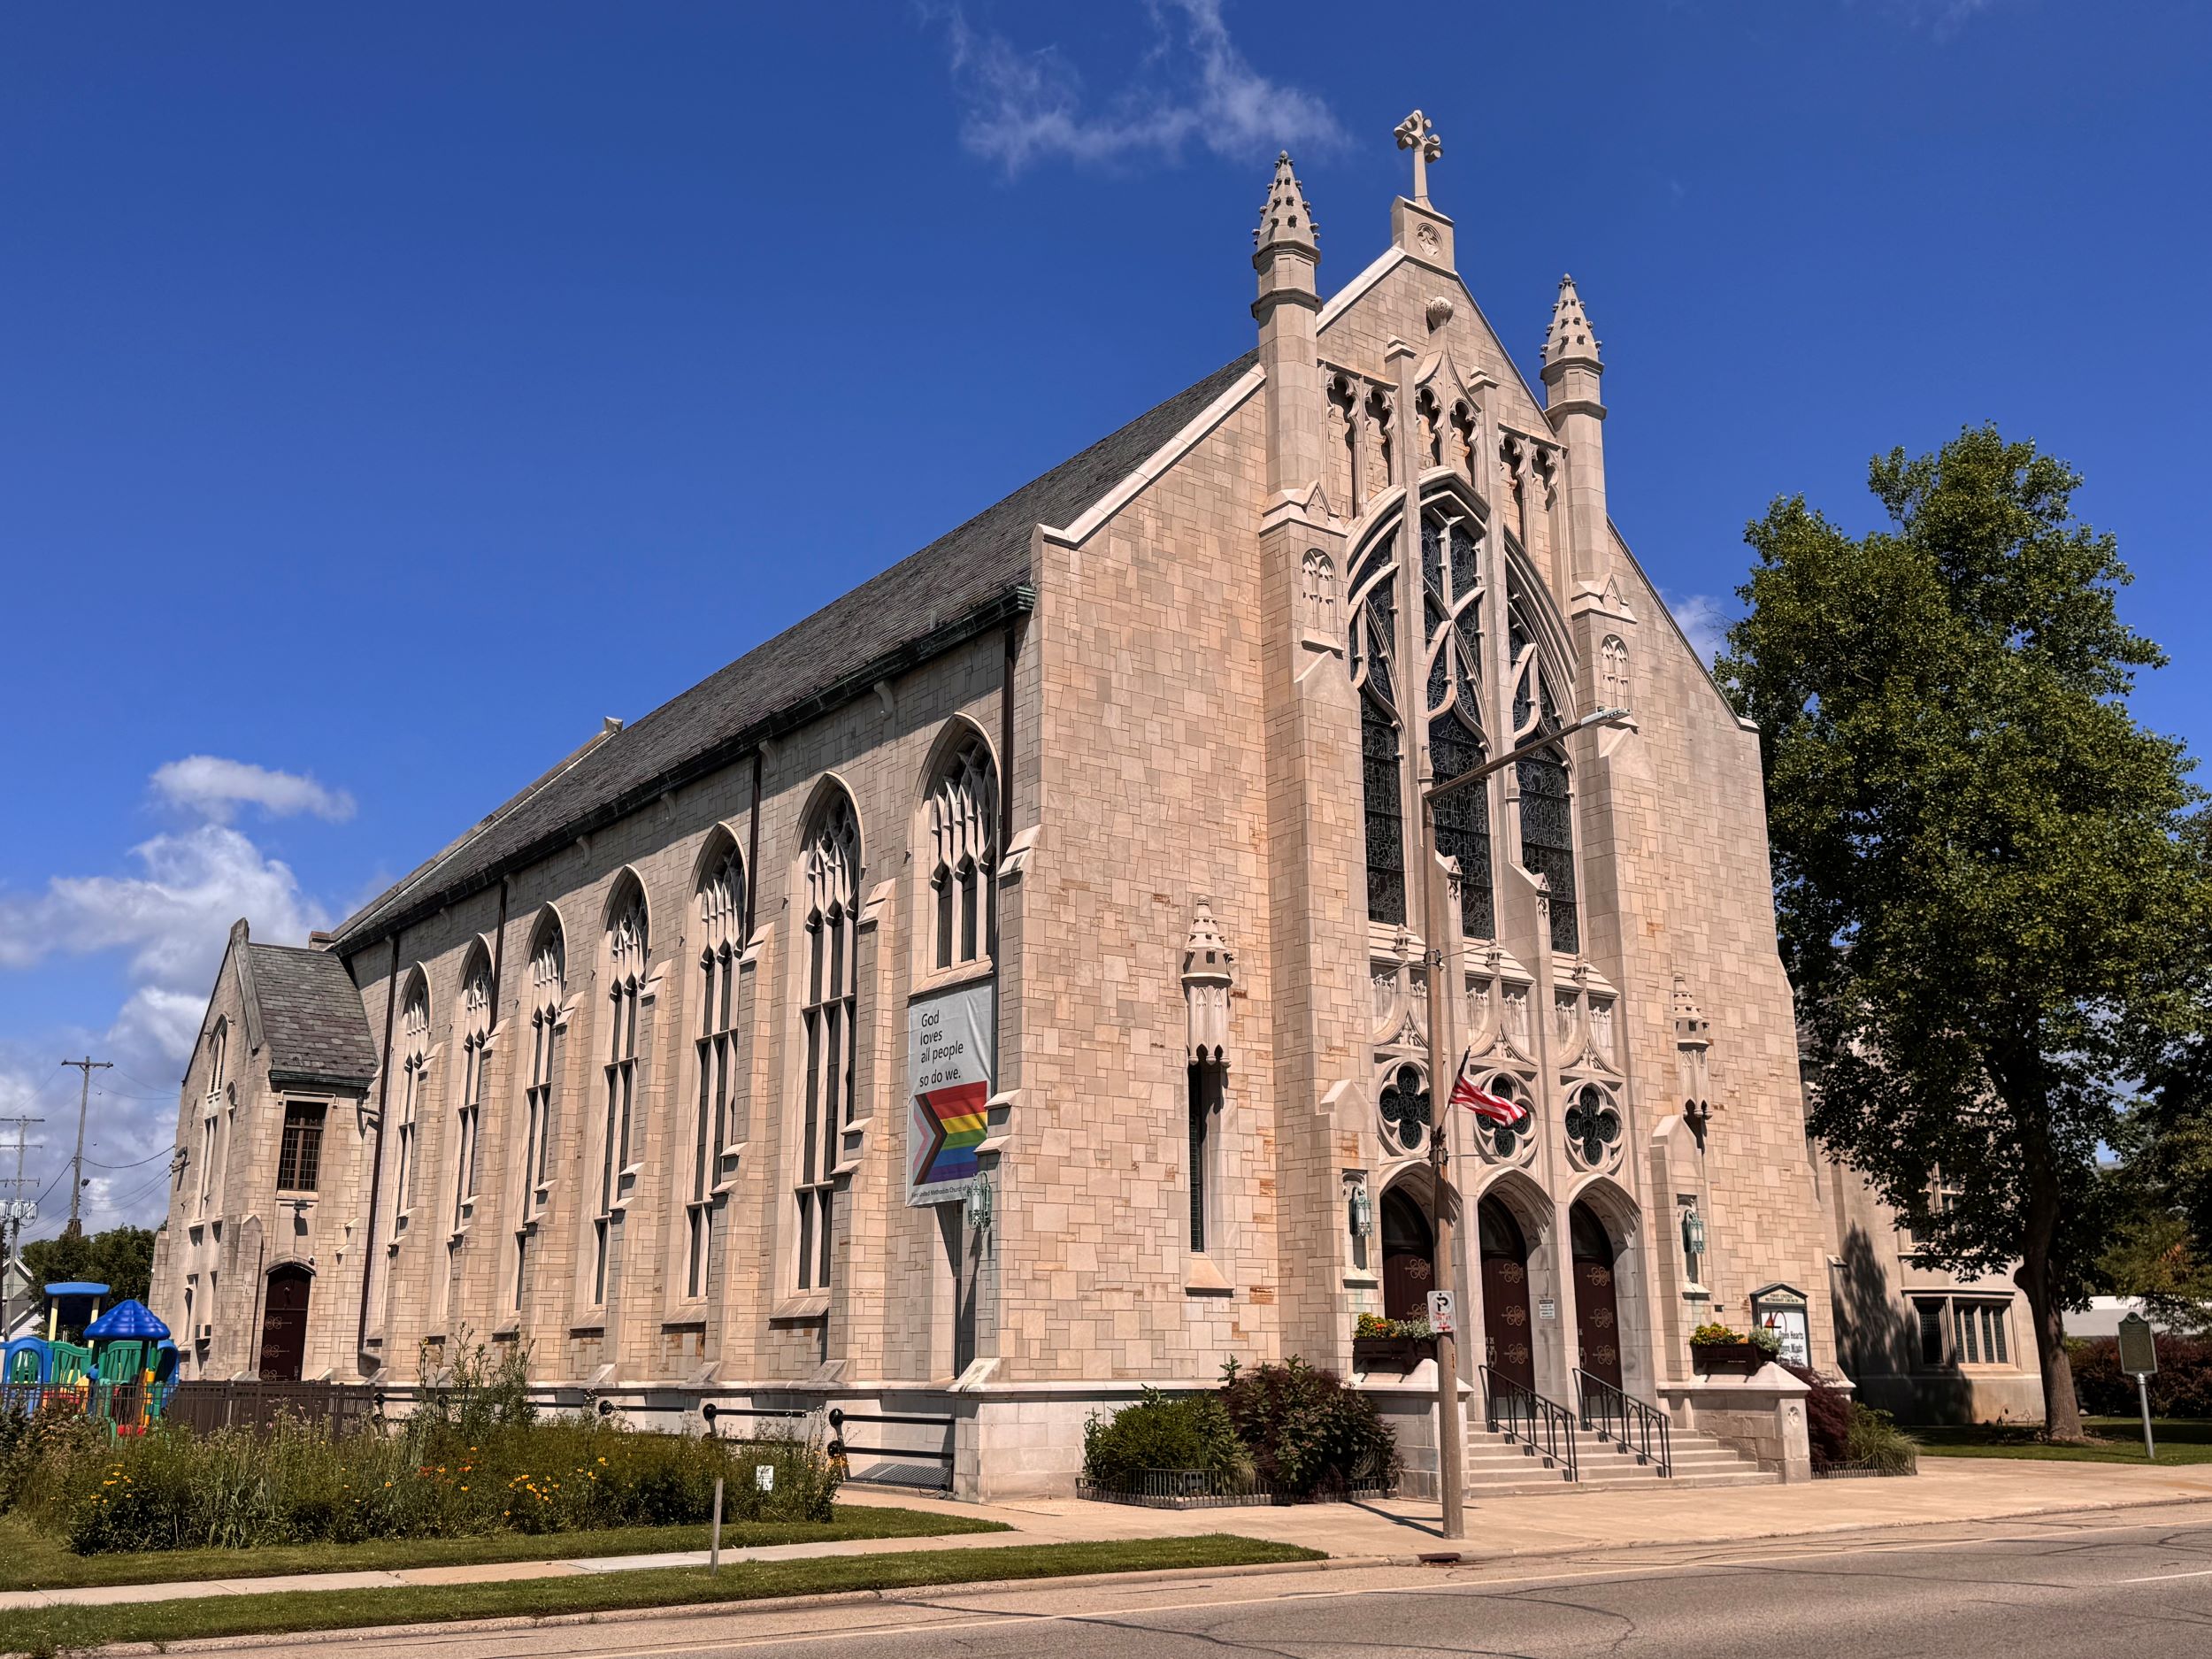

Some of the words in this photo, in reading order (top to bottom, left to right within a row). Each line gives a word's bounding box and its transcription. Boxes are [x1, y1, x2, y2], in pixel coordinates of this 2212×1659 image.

[921, 1010, 940, 1027] God
[920, 1030, 942, 1046] loves
[920, 1047, 931, 1064] all
[932, 1041, 964, 1064] people
[919, 1075, 929, 1087] so
[931, 1069, 943, 1084] do
[945, 1068, 961, 1081] we.
[1790, 1331, 1804, 1340] Hearts
